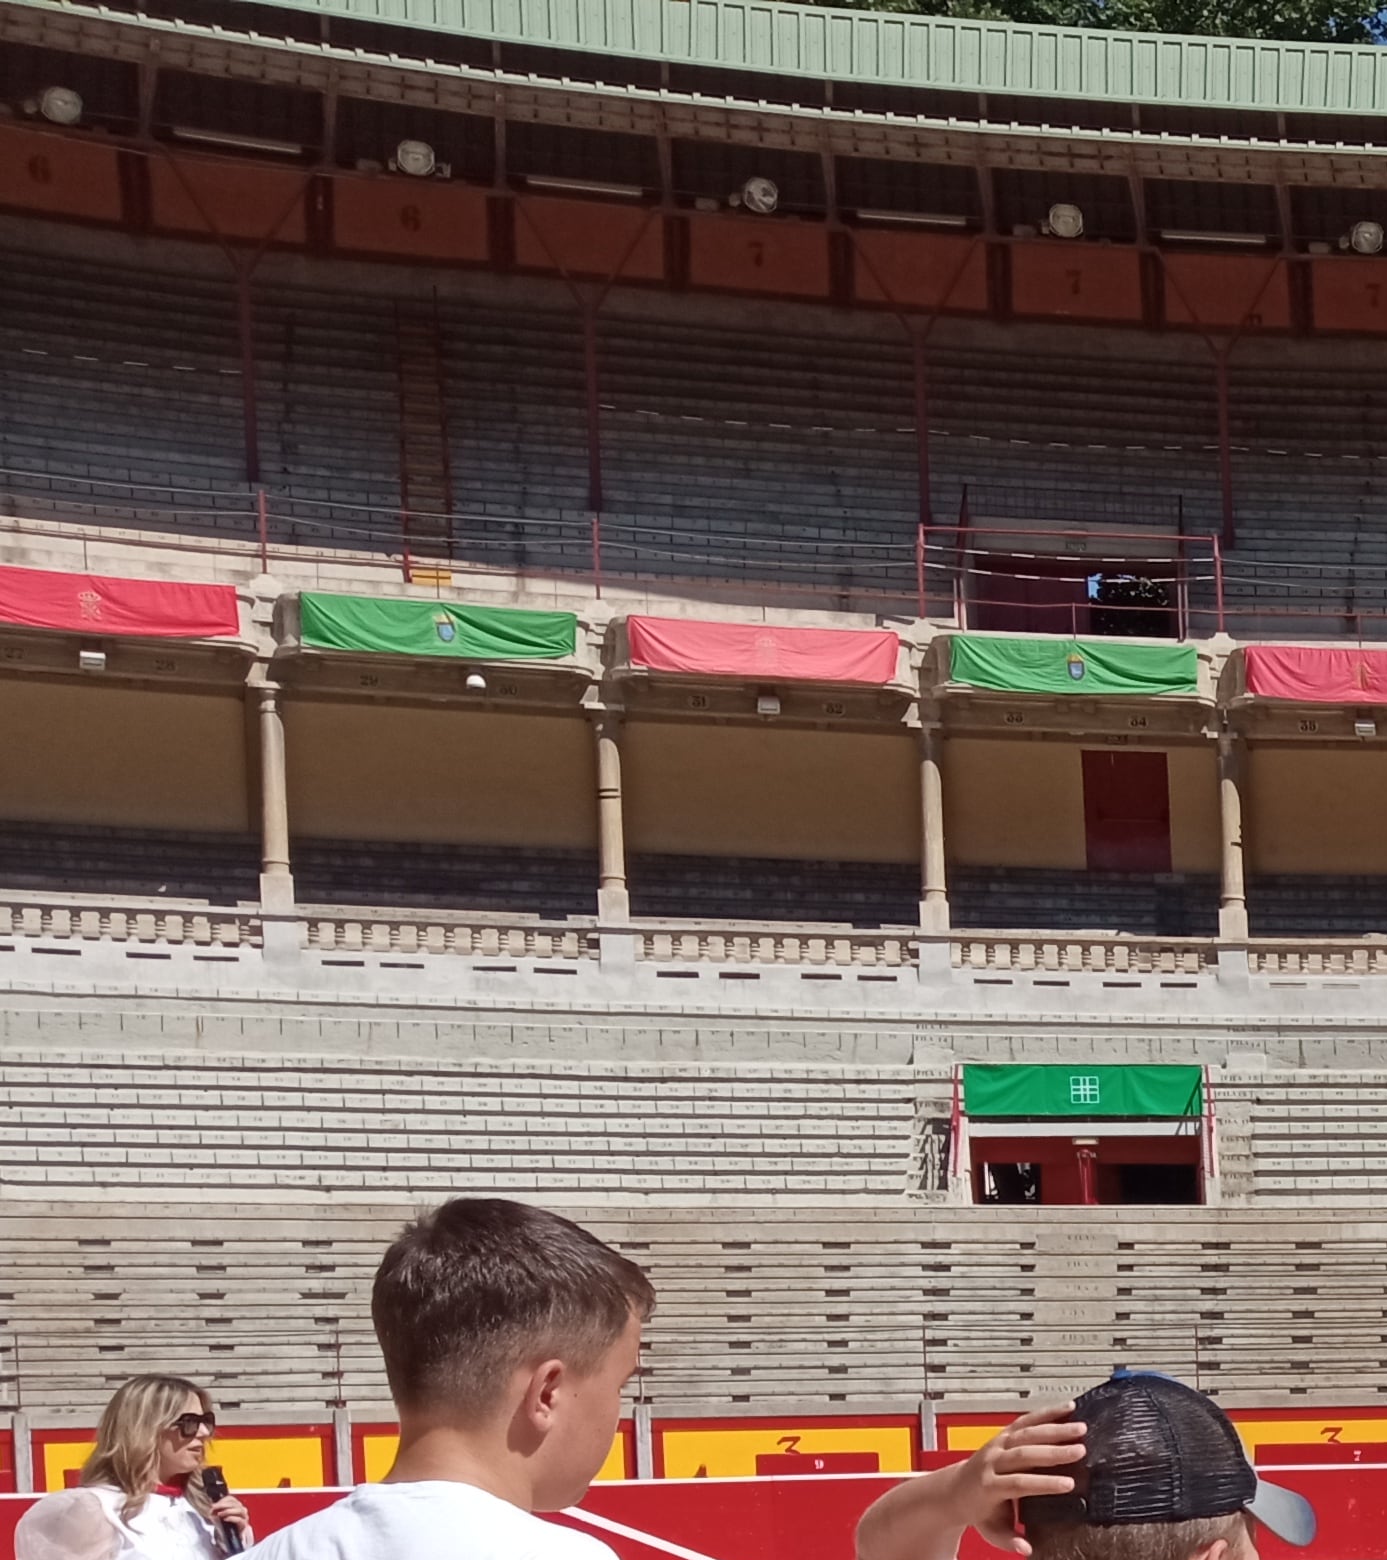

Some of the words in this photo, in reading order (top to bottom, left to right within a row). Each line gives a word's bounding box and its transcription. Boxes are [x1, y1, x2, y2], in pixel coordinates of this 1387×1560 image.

[400, 205, 421, 233] 6
[747, 241, 765, 269] 7
[1066, 268, 1083, 295] 7
[1365, 282, 1381, 308] 7
